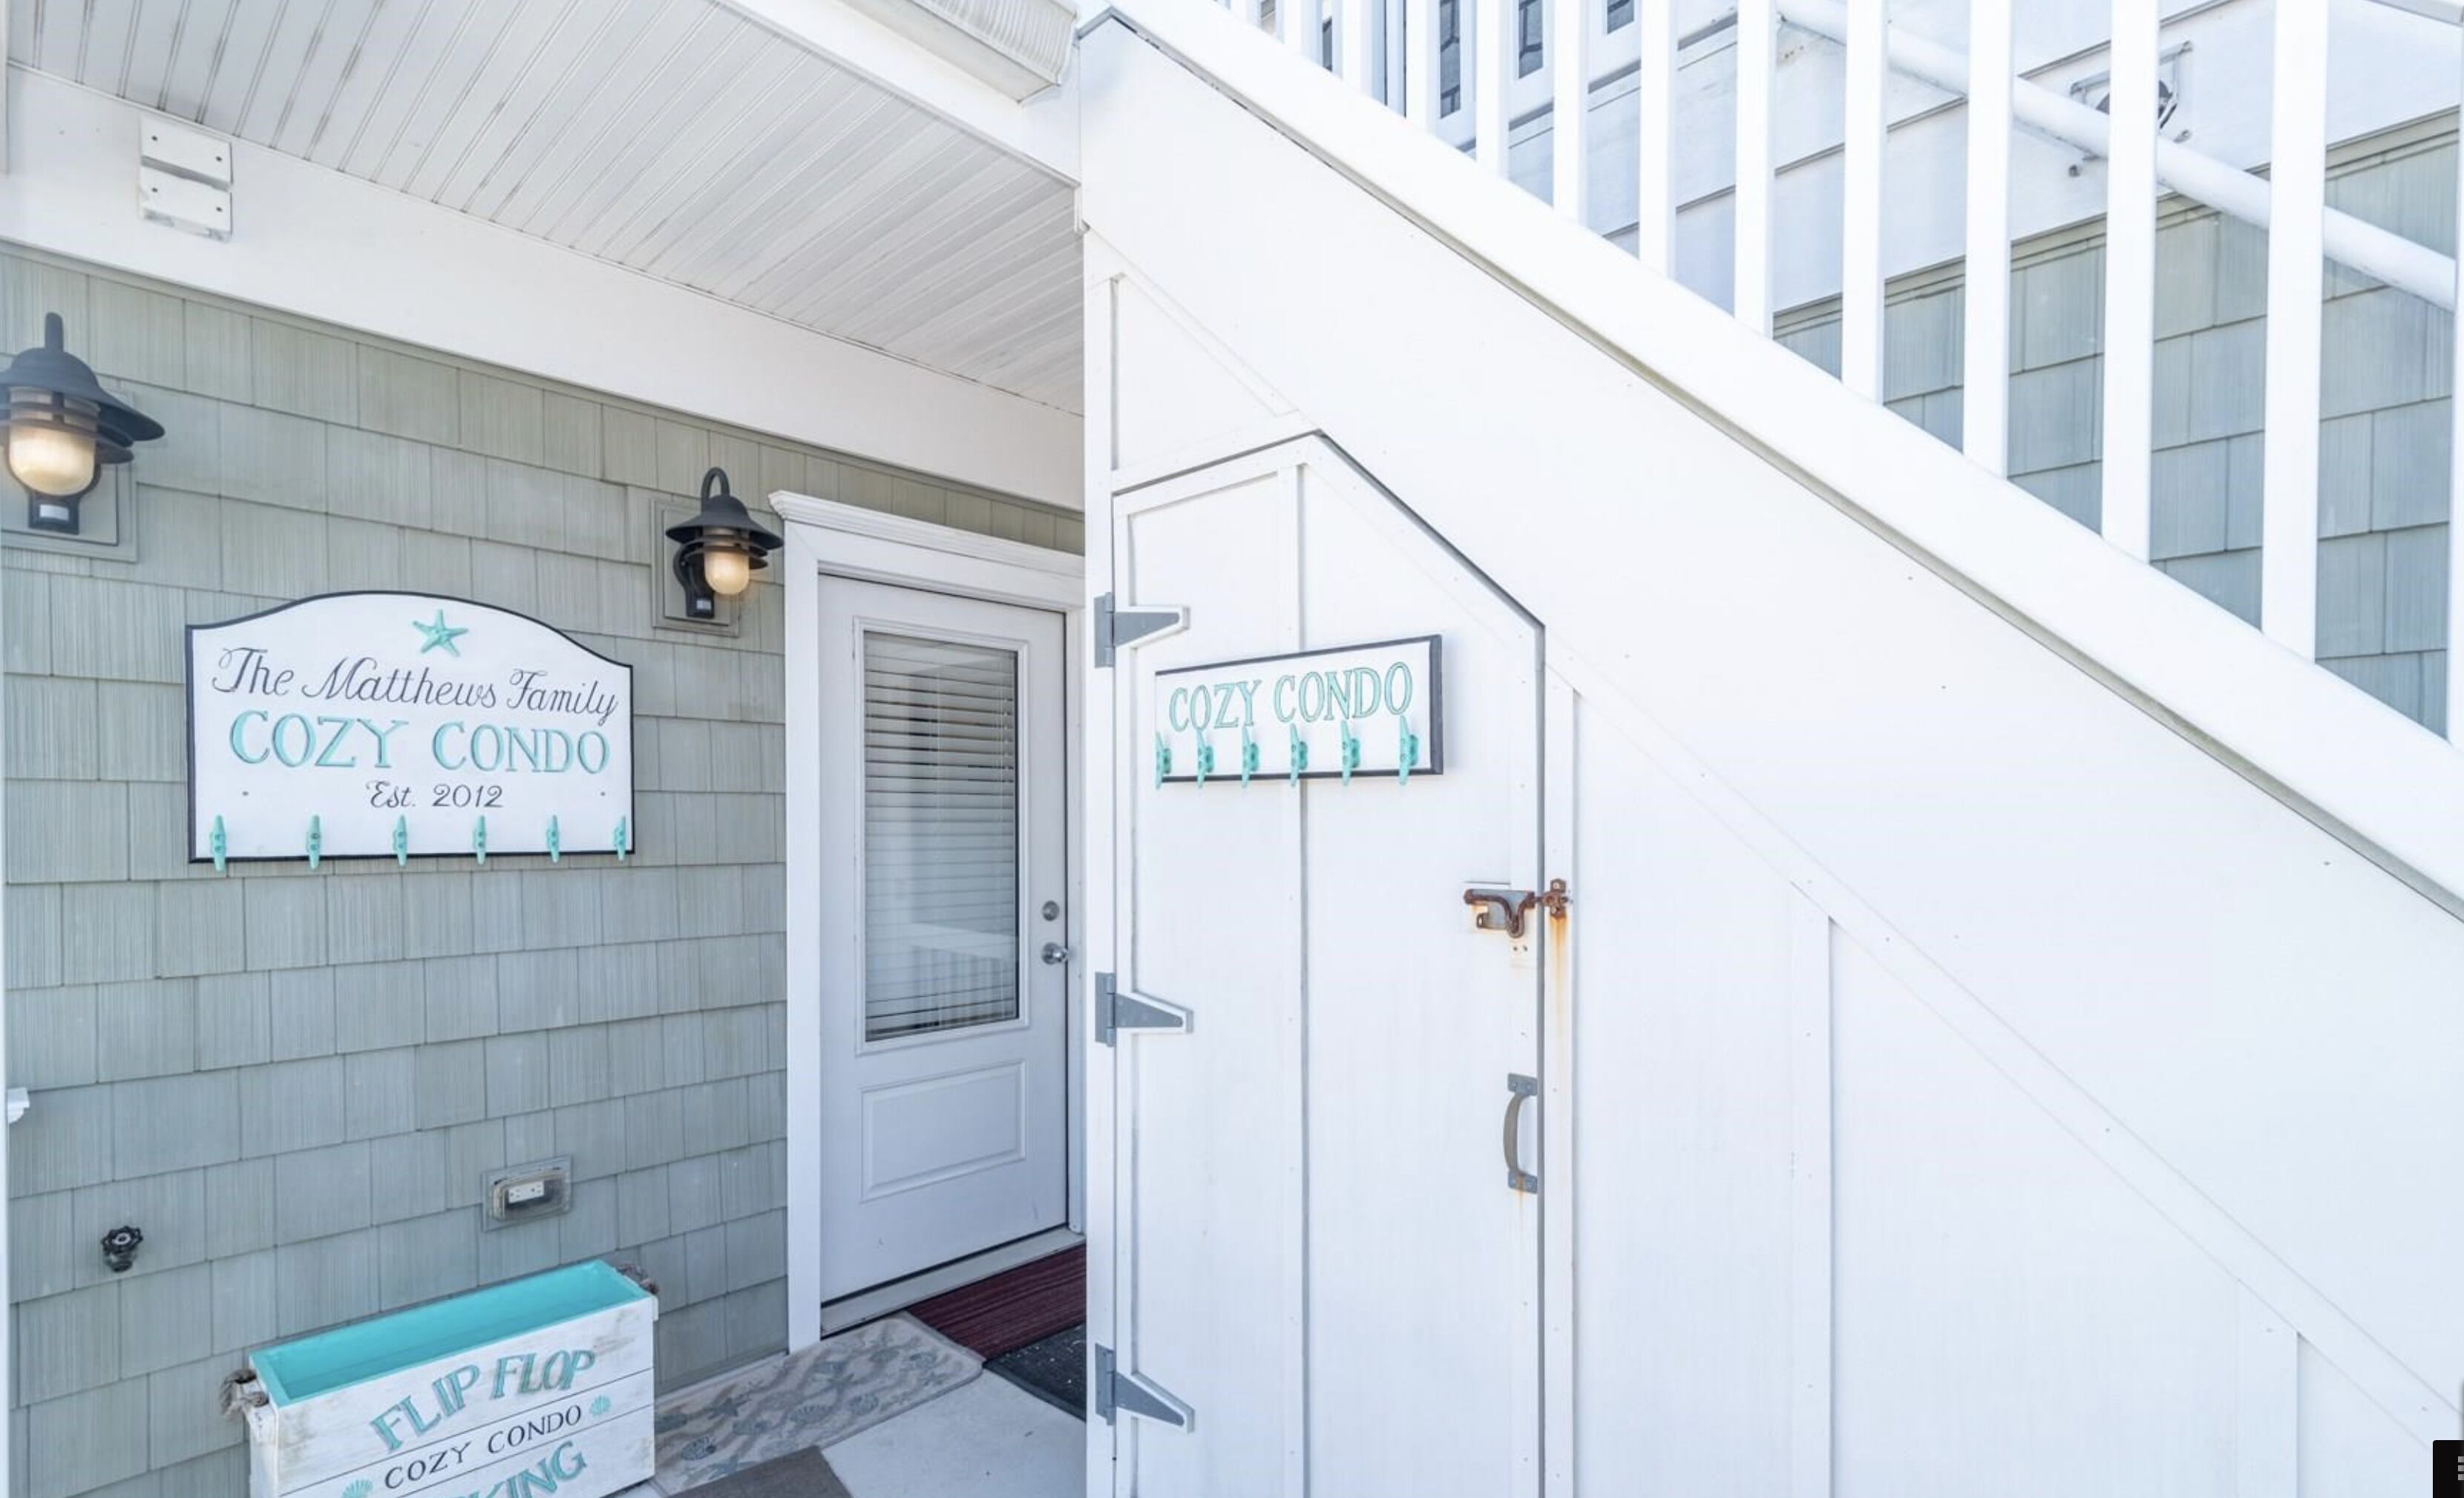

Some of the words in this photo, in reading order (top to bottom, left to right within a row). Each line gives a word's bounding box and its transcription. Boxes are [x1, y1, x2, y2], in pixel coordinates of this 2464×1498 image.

[212, 647, 295, 697] The
[302, 657, 497, 710] Matthews
[506, 669, 620, 727] Family
[1169, 680, 1262, 732] COZY
[1274, 661, 1412, 723] CONDO
[229, 710, 410, 769] COZY
[432, 720, 611, 774] CONDO
[365, 780, 416, 809] Est.
[432, 784, 505, 809] 2012
[370, 1364, 481, 1452] FLIP
[491, 1349, 596, 1400] FLOP
[384, 1443, 472, 1489] COZY
[488, 1404, 582, 1454] CONDO
[454, 1441, 587, 1498] ING
